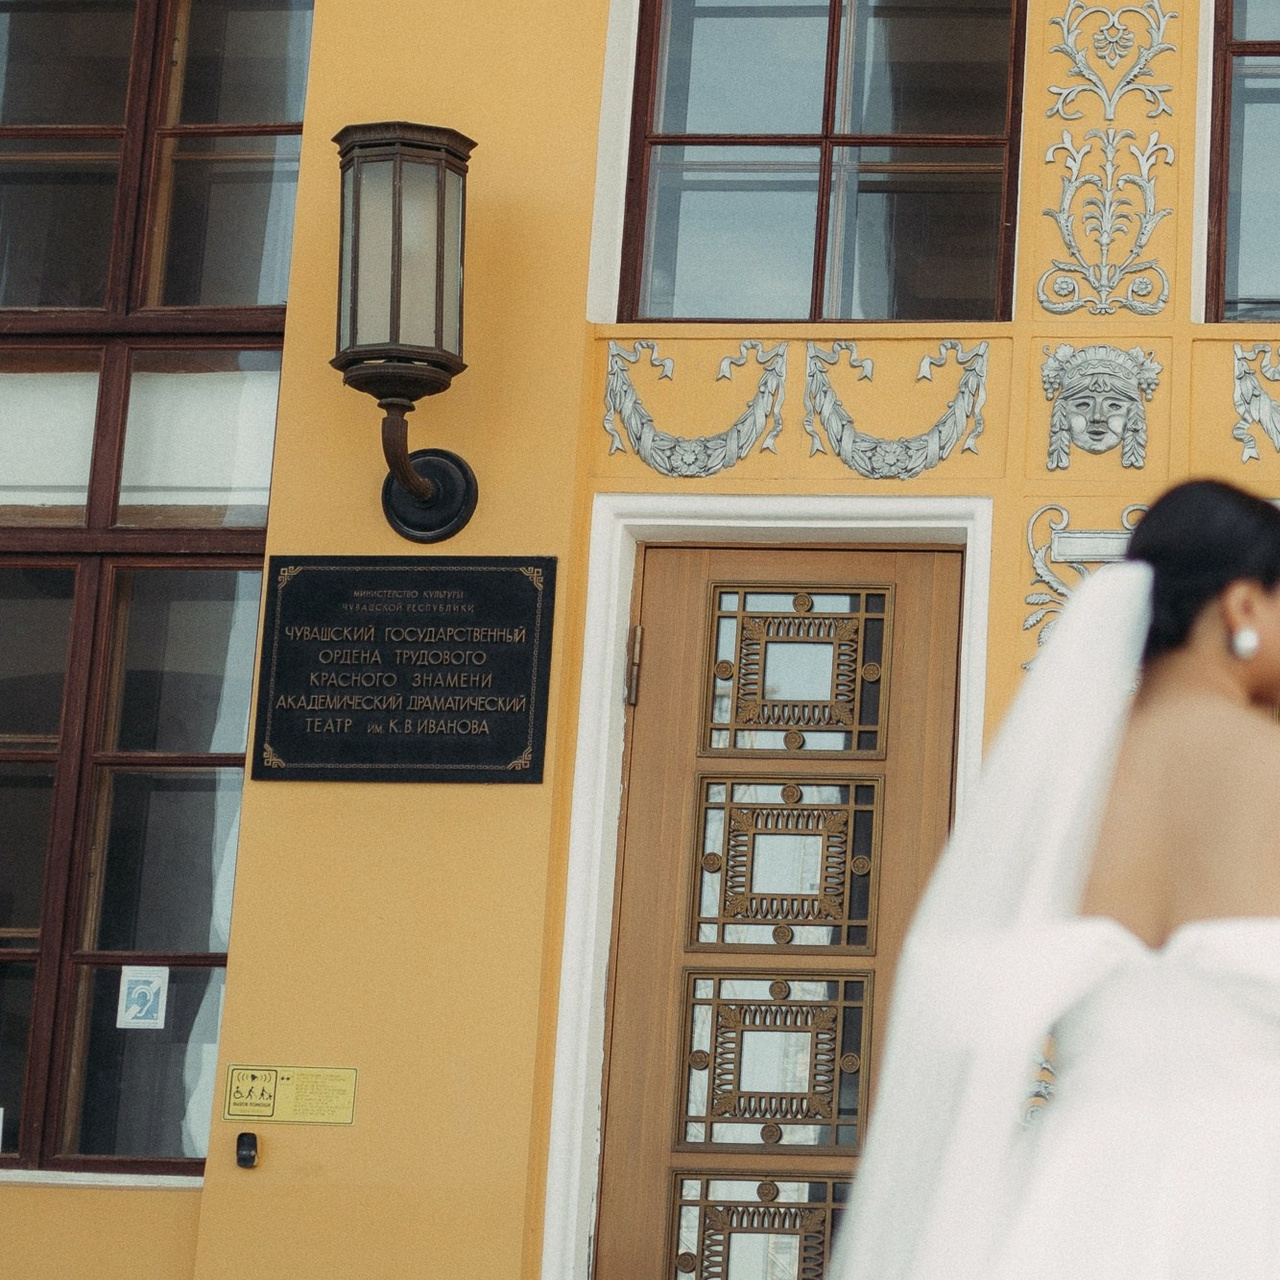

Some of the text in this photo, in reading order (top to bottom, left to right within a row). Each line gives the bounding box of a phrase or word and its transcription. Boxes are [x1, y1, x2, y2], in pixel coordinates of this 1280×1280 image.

[353, 589, 464, 599] МИНИСТЕРСТВО КУЛЬТУРЫ
[407, 604, 474, 613] РЕСПУБЛИКИ
[285, 624, 526, 643] ЧУВАШСКИЙ ГОСУДАРСТВЕННЫЙ
[318, 649, 486, 666] ОРДЕНА ТРУДОВОГО
[310, 672, 492, 688] КРАСНОГО ЗНАМЕНИ
[276, 693, 526, 712] АКАДЕМИЧЕСКИЙ ДРАМАТИЧЕСКИЙ
[305, 718, 353, 733] ТЕАТР
[417, 719, 489, 734] ИВАНОВА
